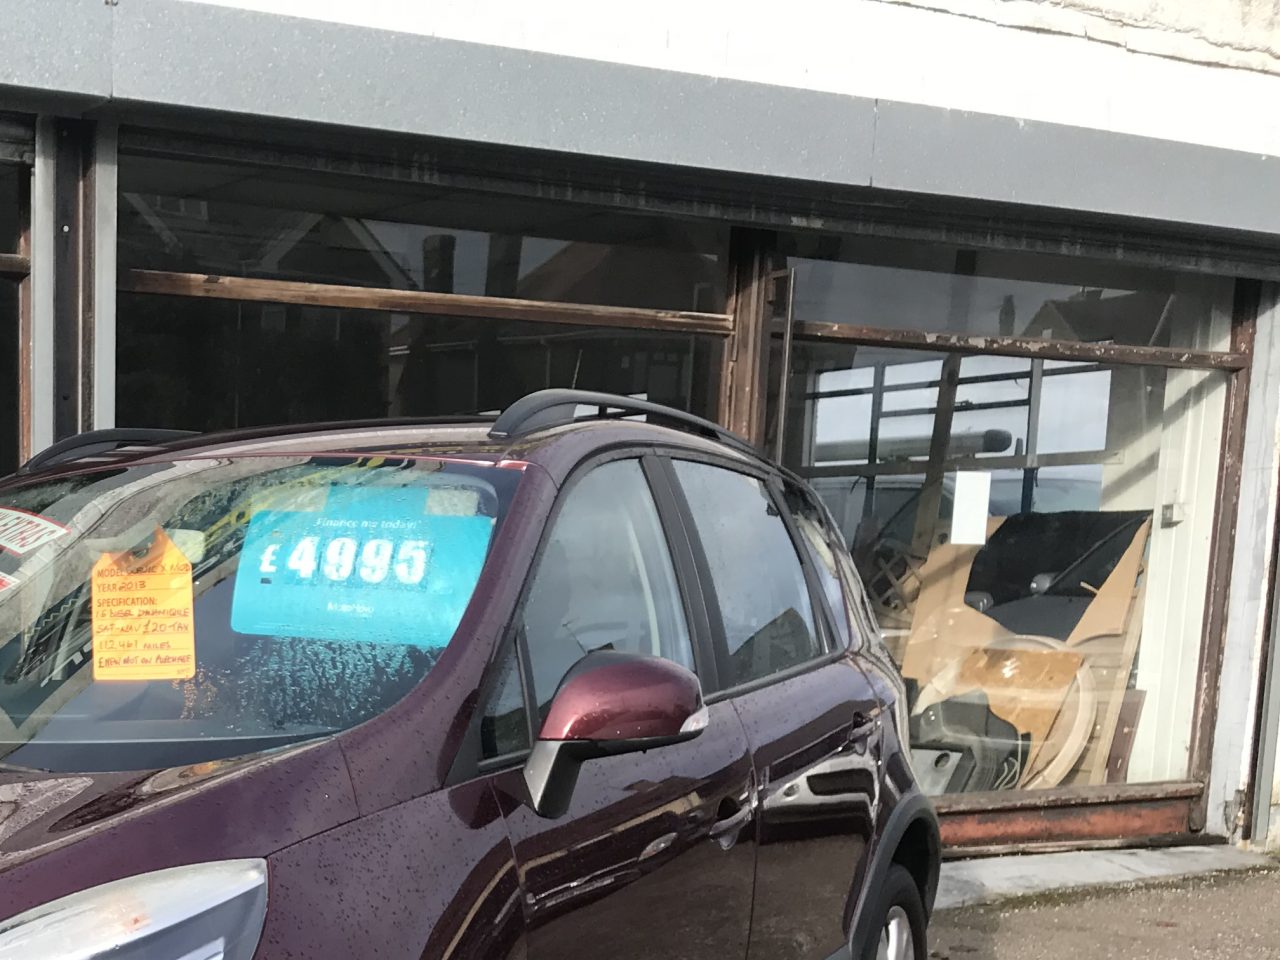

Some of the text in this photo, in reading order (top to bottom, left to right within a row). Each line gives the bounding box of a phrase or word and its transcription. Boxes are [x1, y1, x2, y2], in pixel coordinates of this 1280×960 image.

[313, 517, 359, 529] Finance
[96, 567, 125, 578] MODEL
[96, 580, 146, 592] YEAR 2013
